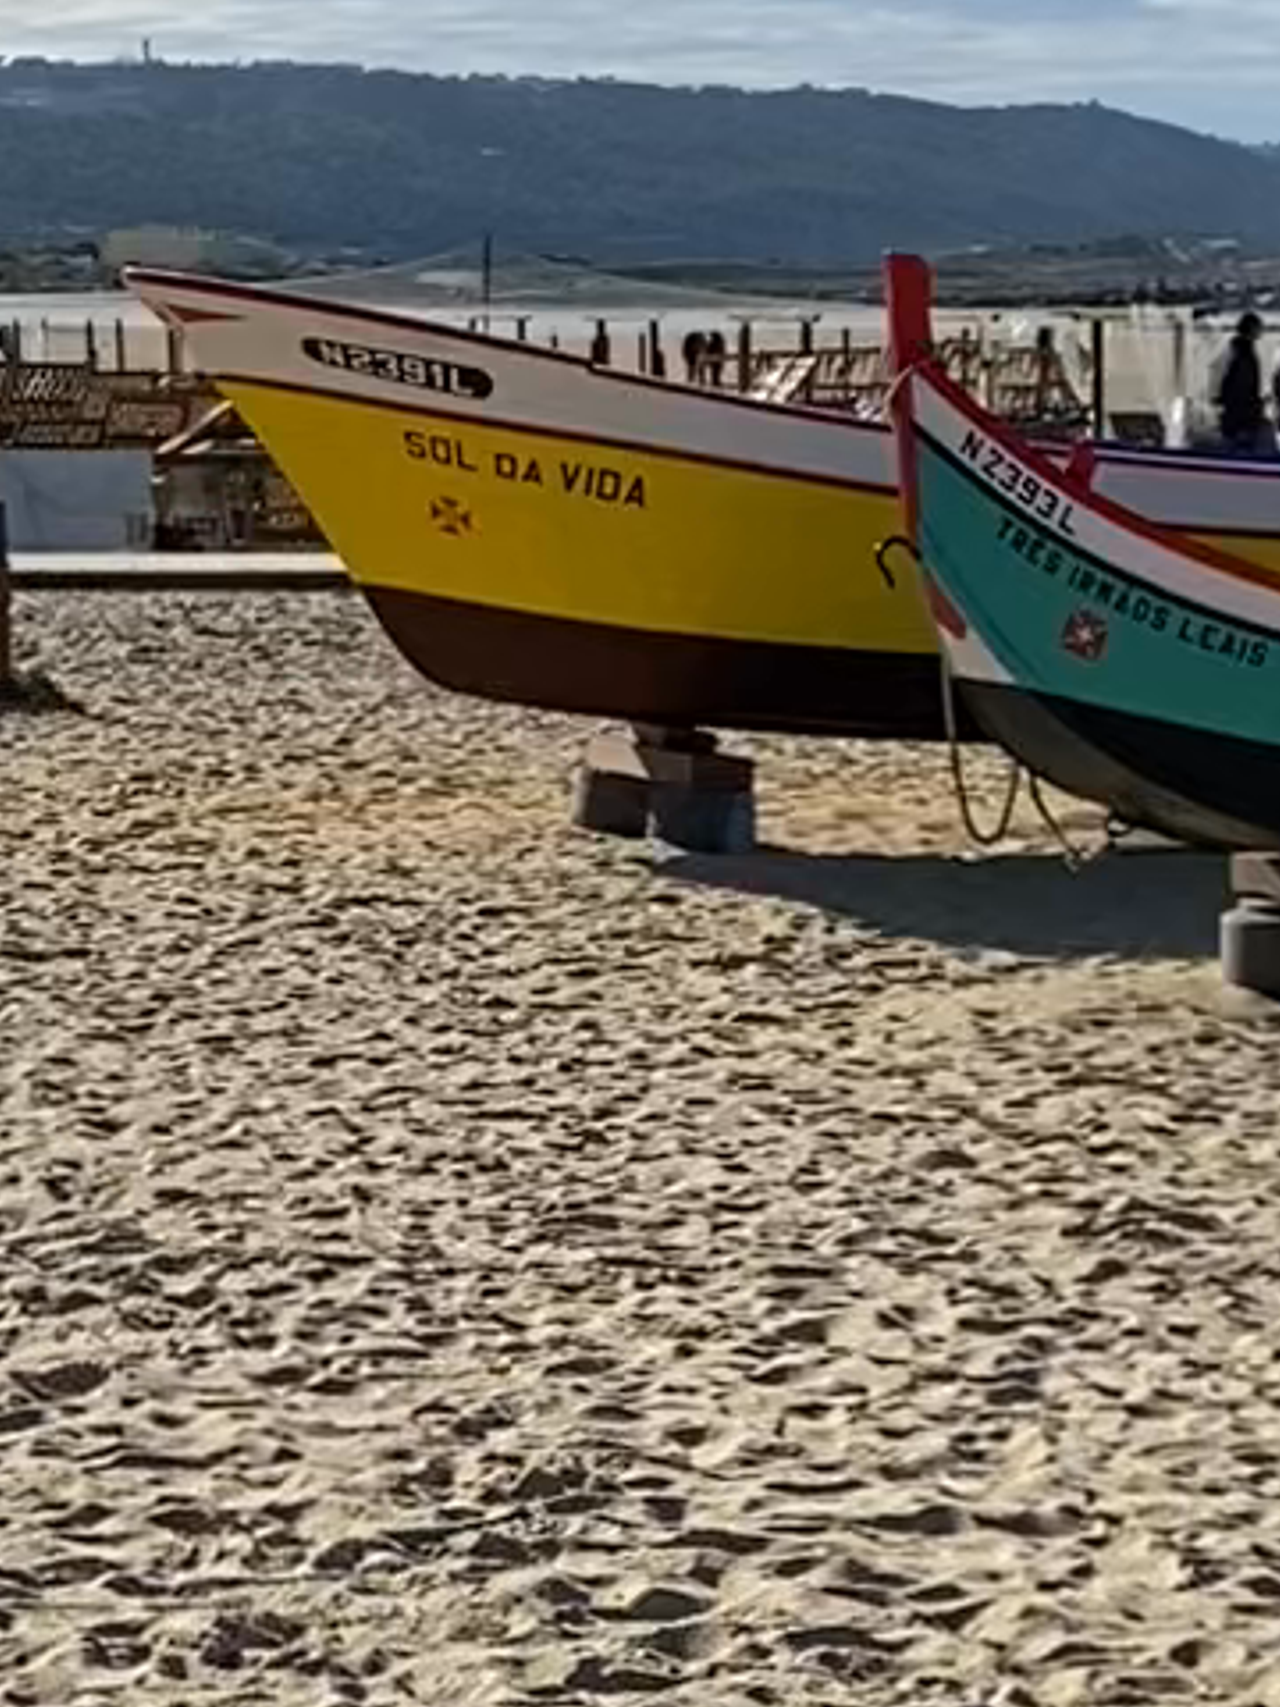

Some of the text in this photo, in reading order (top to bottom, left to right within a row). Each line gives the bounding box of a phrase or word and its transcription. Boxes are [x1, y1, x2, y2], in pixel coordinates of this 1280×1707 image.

[404, 430, 645, 508] SOL DA VIDA
[1176, 617, 1269, 668] LEAIS
